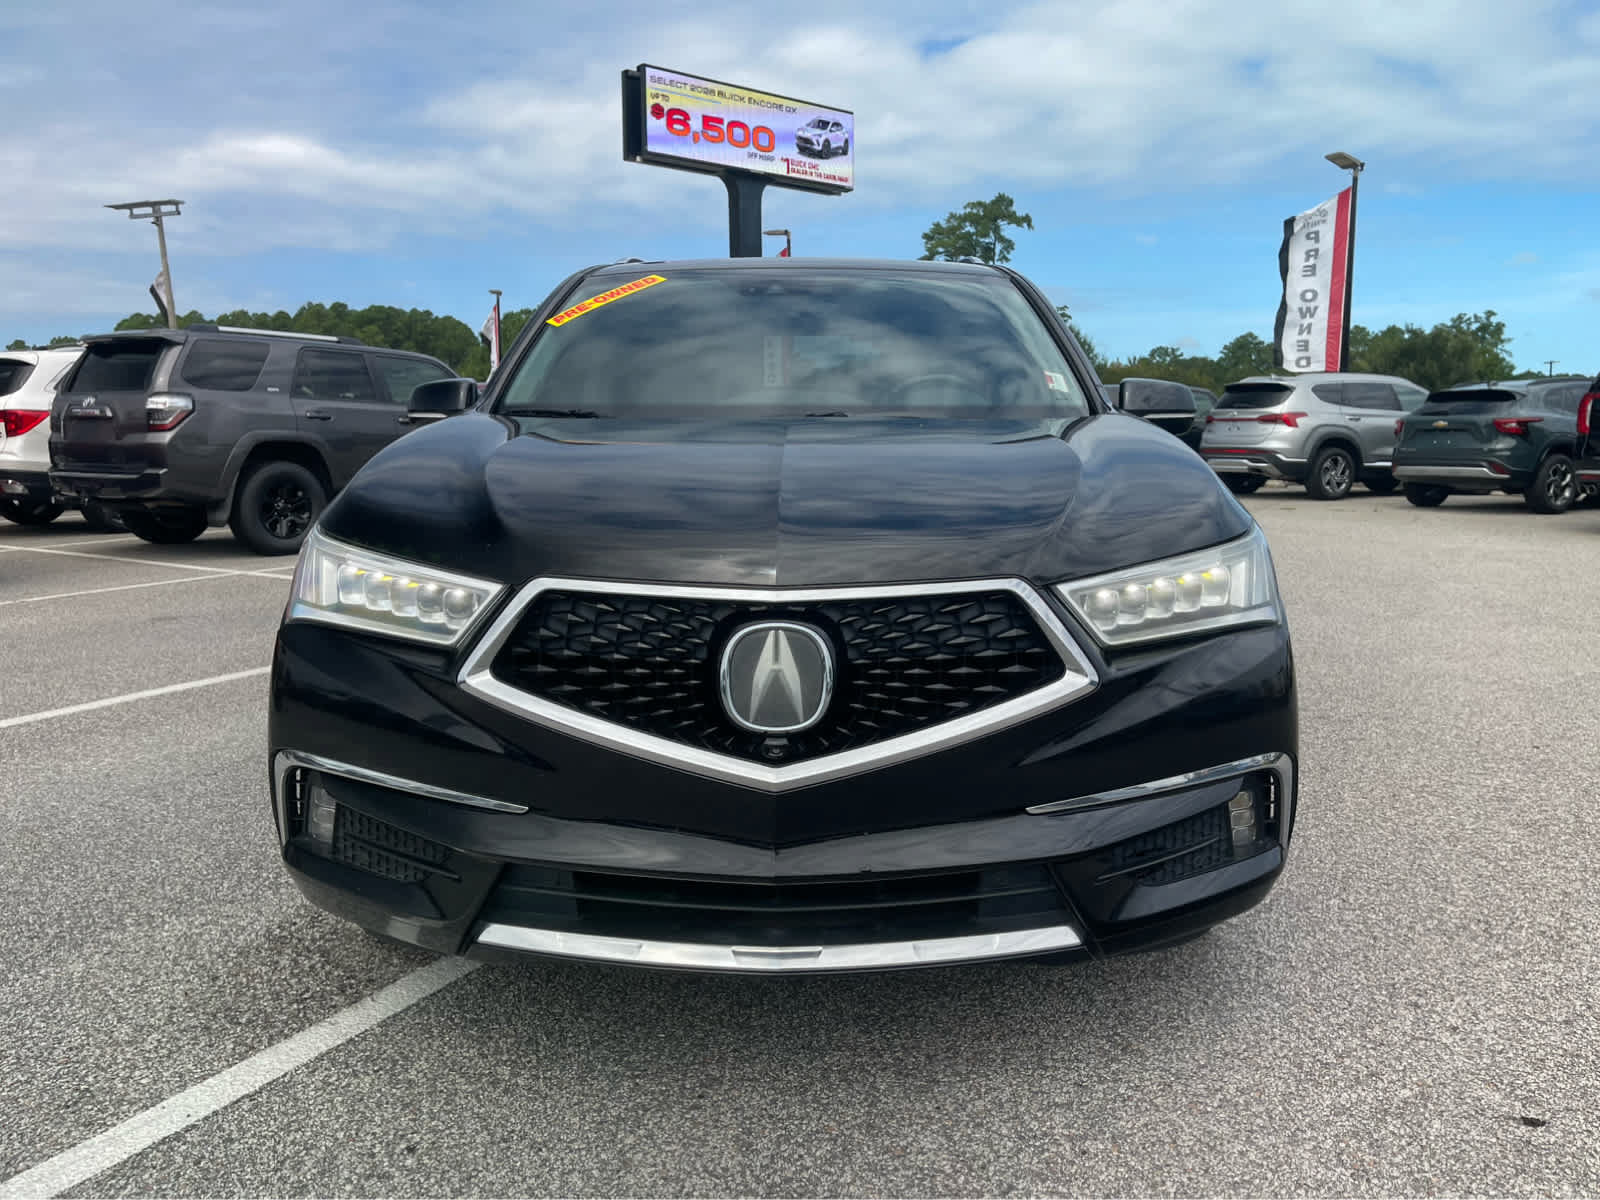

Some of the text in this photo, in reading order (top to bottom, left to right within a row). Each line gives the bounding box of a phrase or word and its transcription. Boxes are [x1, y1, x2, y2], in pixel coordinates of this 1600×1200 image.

[649, 75, 688, 89] SELECT
[717, 89, 747, 103] BUICK
[748, 96, 784, 111] ENCORE
[660, 93, 670, 102] TO
[650, 103, 775, 153] $6,500
[552, 277, 658, 324] PRE-OWNED
